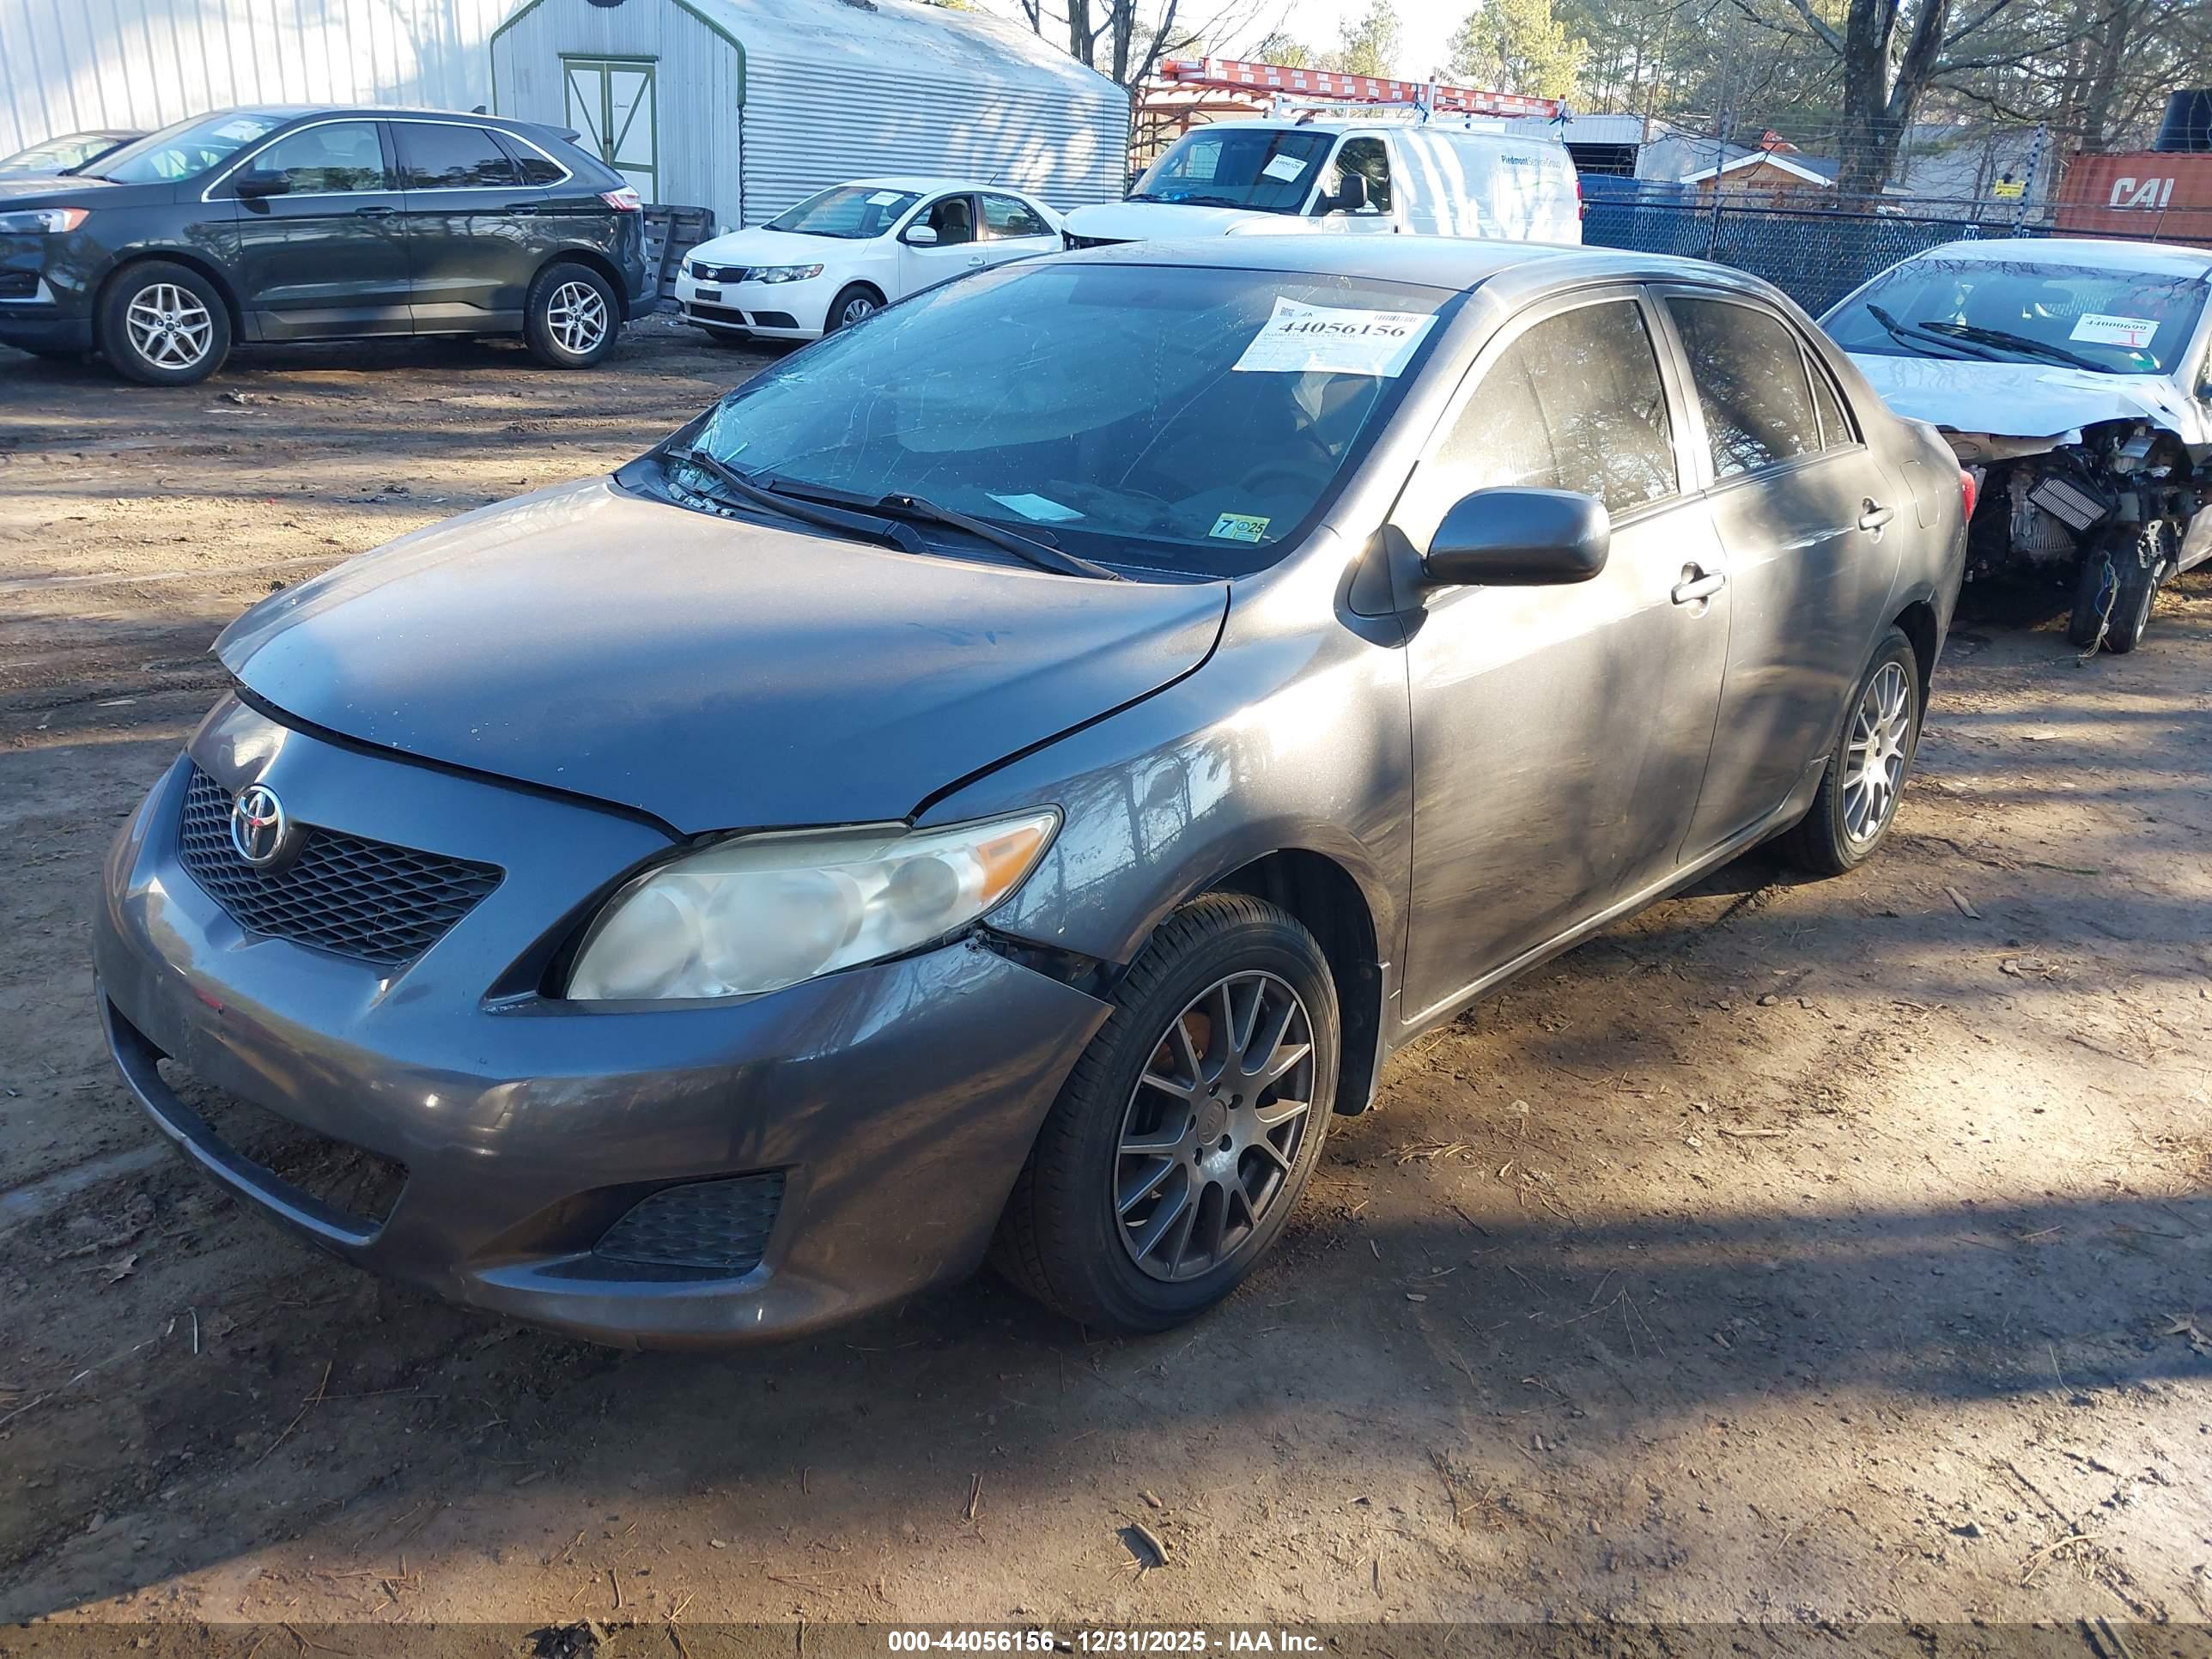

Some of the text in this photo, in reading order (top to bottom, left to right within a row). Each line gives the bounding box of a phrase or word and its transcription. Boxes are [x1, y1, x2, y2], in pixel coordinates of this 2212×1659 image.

[1500, 155, 1528, 166] Piedmont
[2109, 177, 2175, 212] CAI
[1279, 321, 1406, 337] 44056156
[1218, 520, 1267, 534] 7 25
